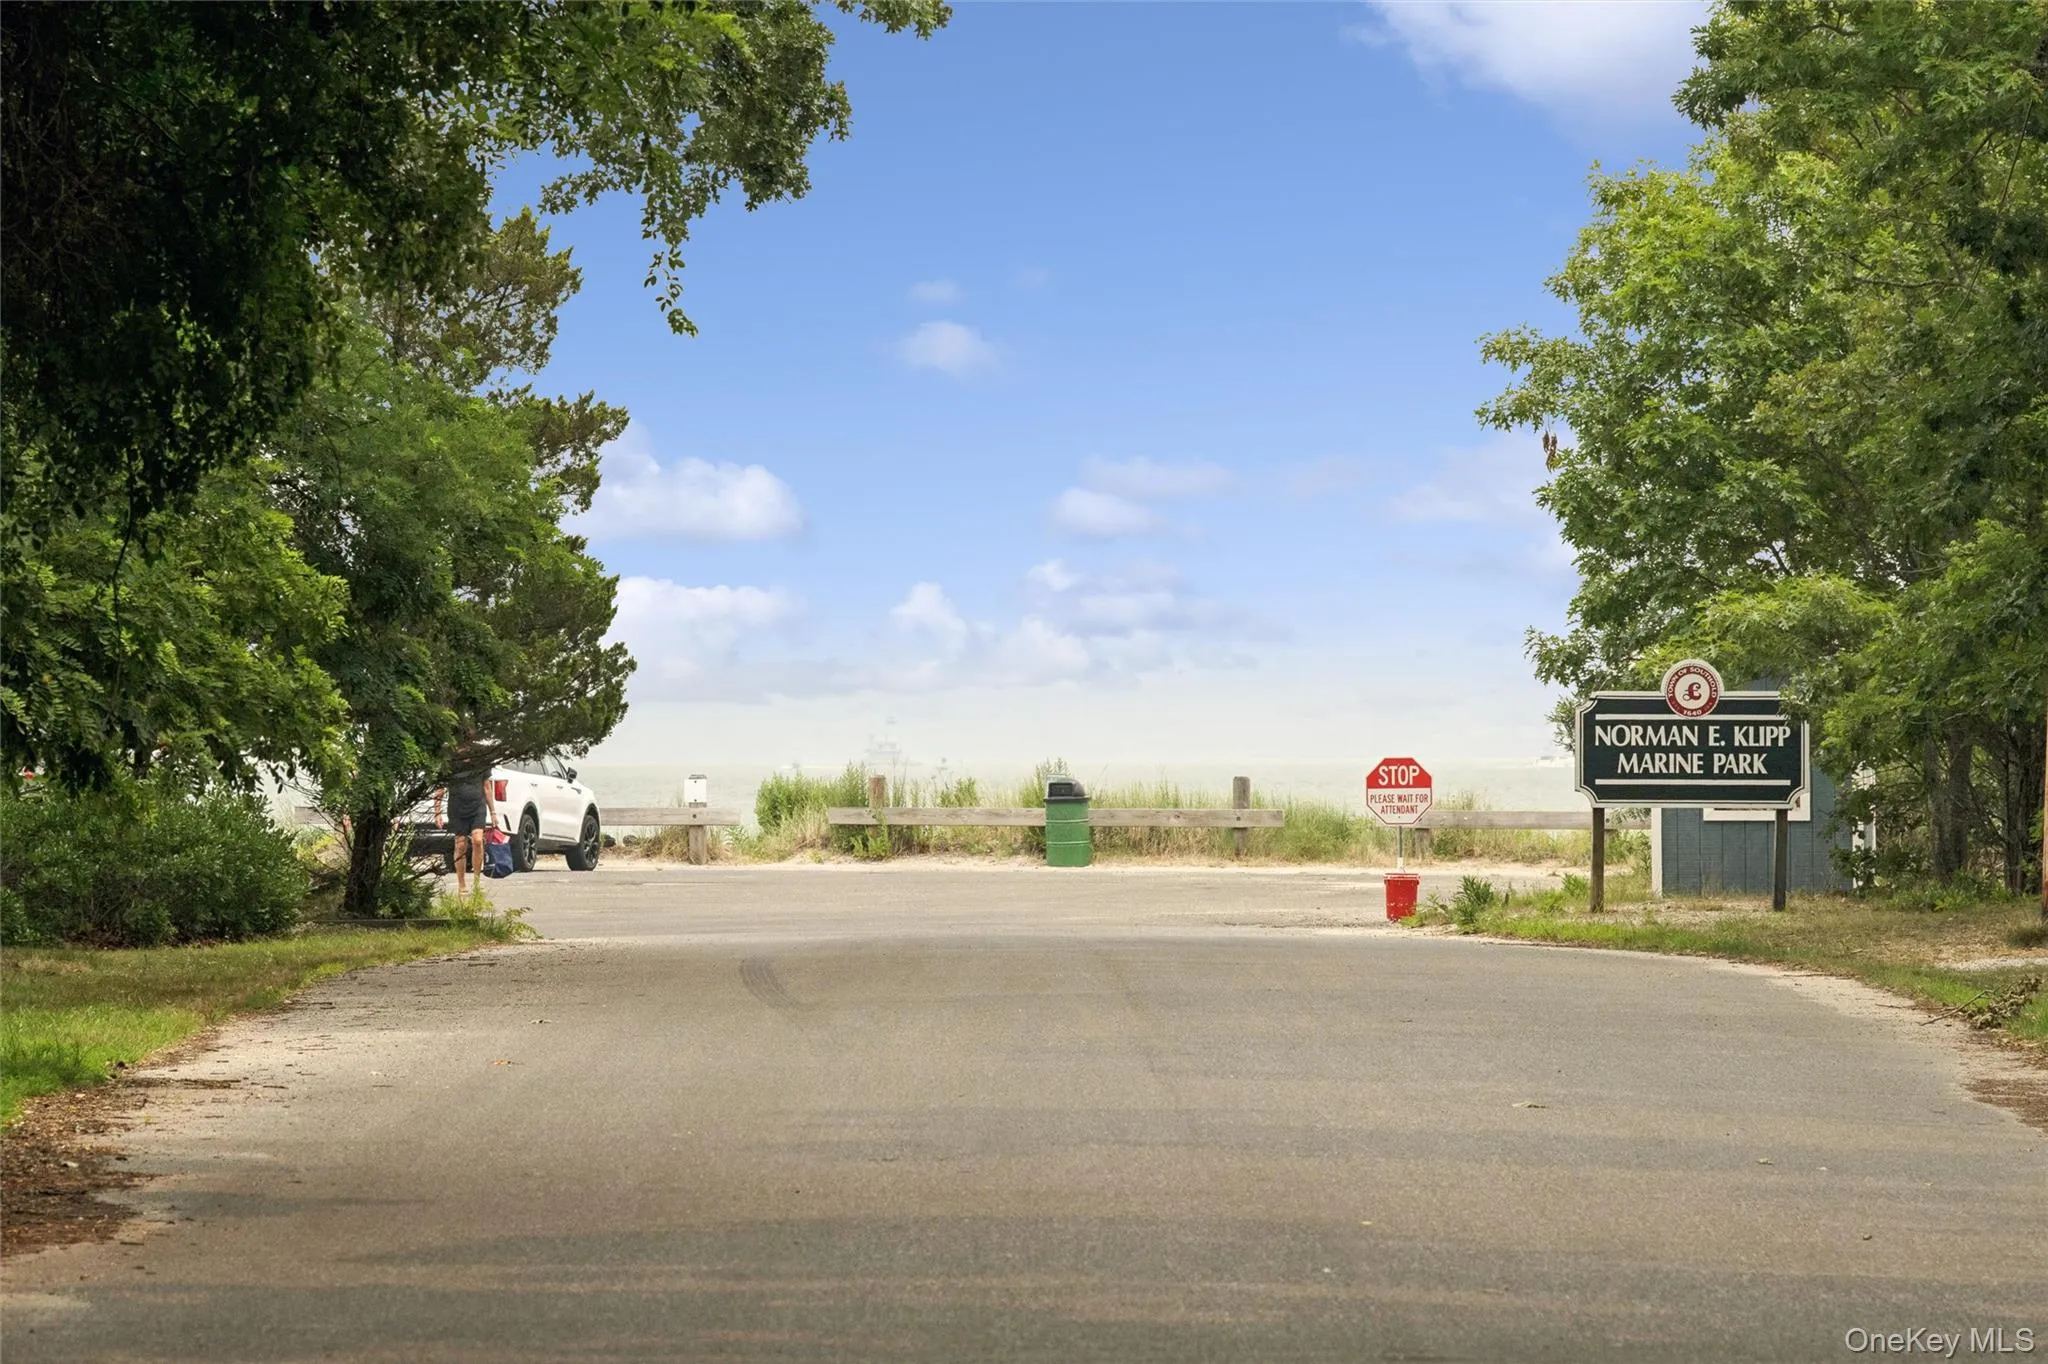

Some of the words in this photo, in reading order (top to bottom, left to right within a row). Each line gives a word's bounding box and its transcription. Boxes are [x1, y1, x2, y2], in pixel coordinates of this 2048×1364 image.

[1668, 675, 1679, 698] TOWN
[1690, 667, 1717, 698] SOUTHOLD
[1595, 725, 1699, 747] NORMAN
[1708, 726, 1725, 747] E.
[1734, 725, 1791, 747] KLIPP
[1617, 753, 1704, 774] MARINE
[1713, 753, 1768, 774] PARK
[1378, 765, 1420, 786] STOP
[1370, 794, 1395, 803] PLEASE
[1397, 794, 1414, 803] WAIT
[1415, 794, 1429, 803] FOR
[1380, 805, 1418, 814] ATTENDANT
